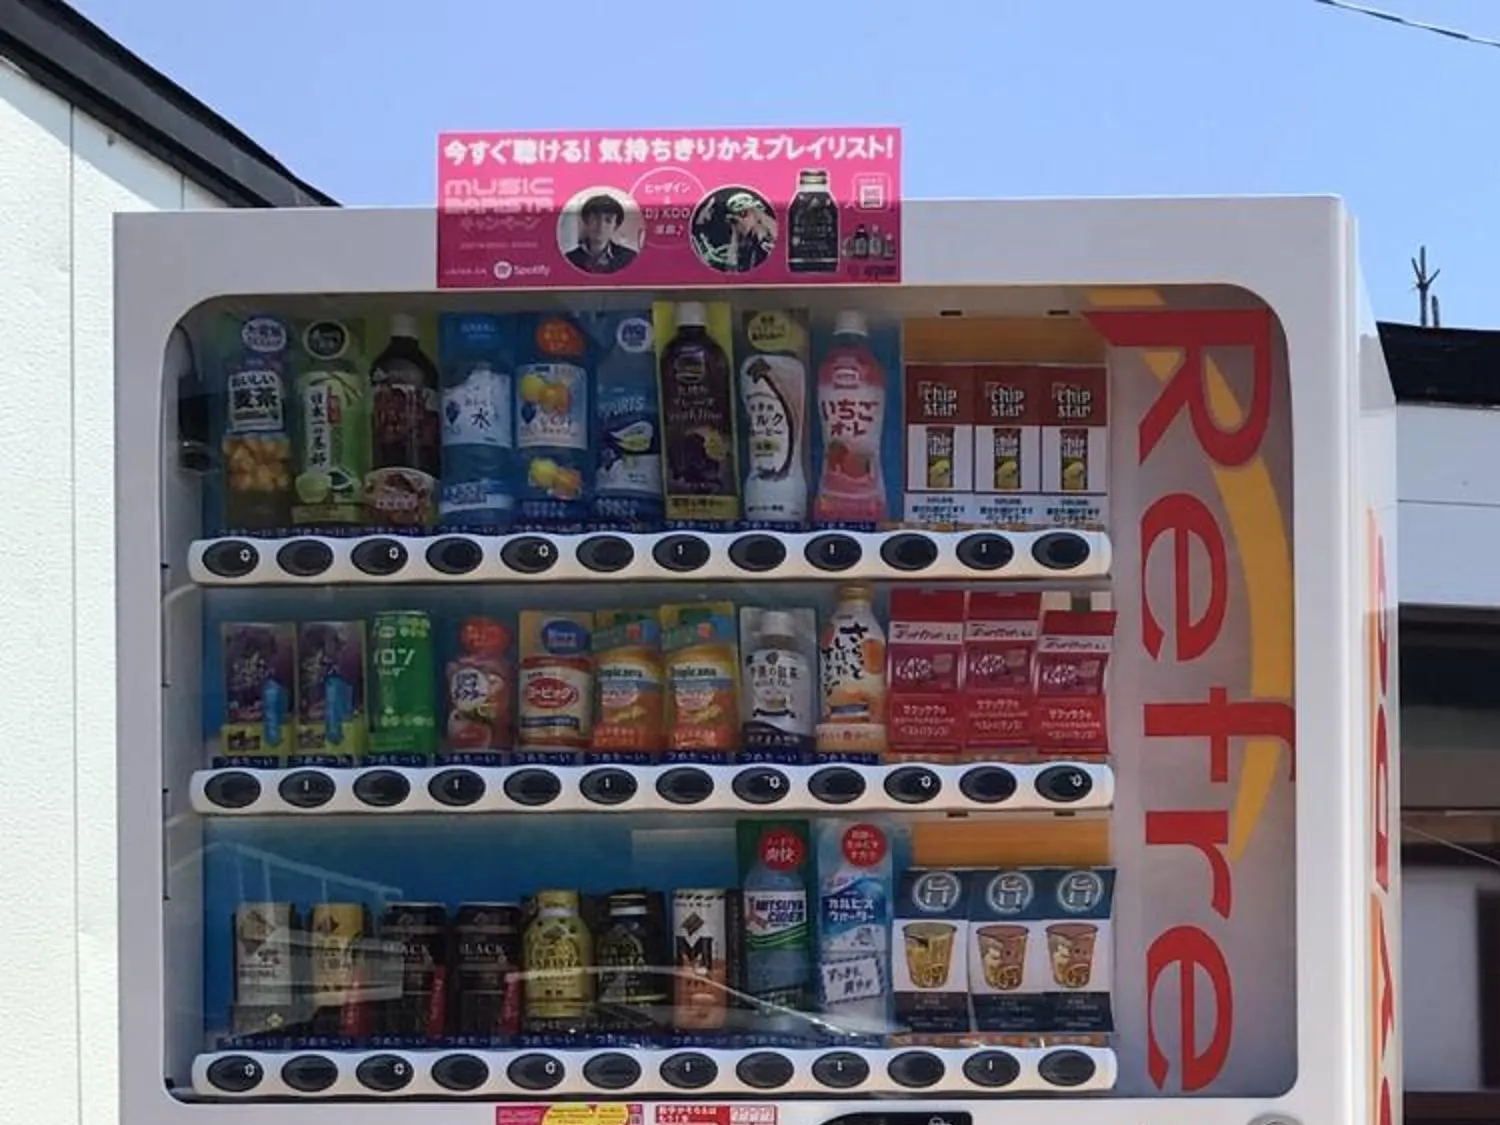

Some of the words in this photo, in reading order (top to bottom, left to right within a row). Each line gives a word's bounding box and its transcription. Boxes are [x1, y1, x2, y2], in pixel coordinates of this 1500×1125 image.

[471, 407, 492, 430] 水
[819, 399, 880, 424] いちご
